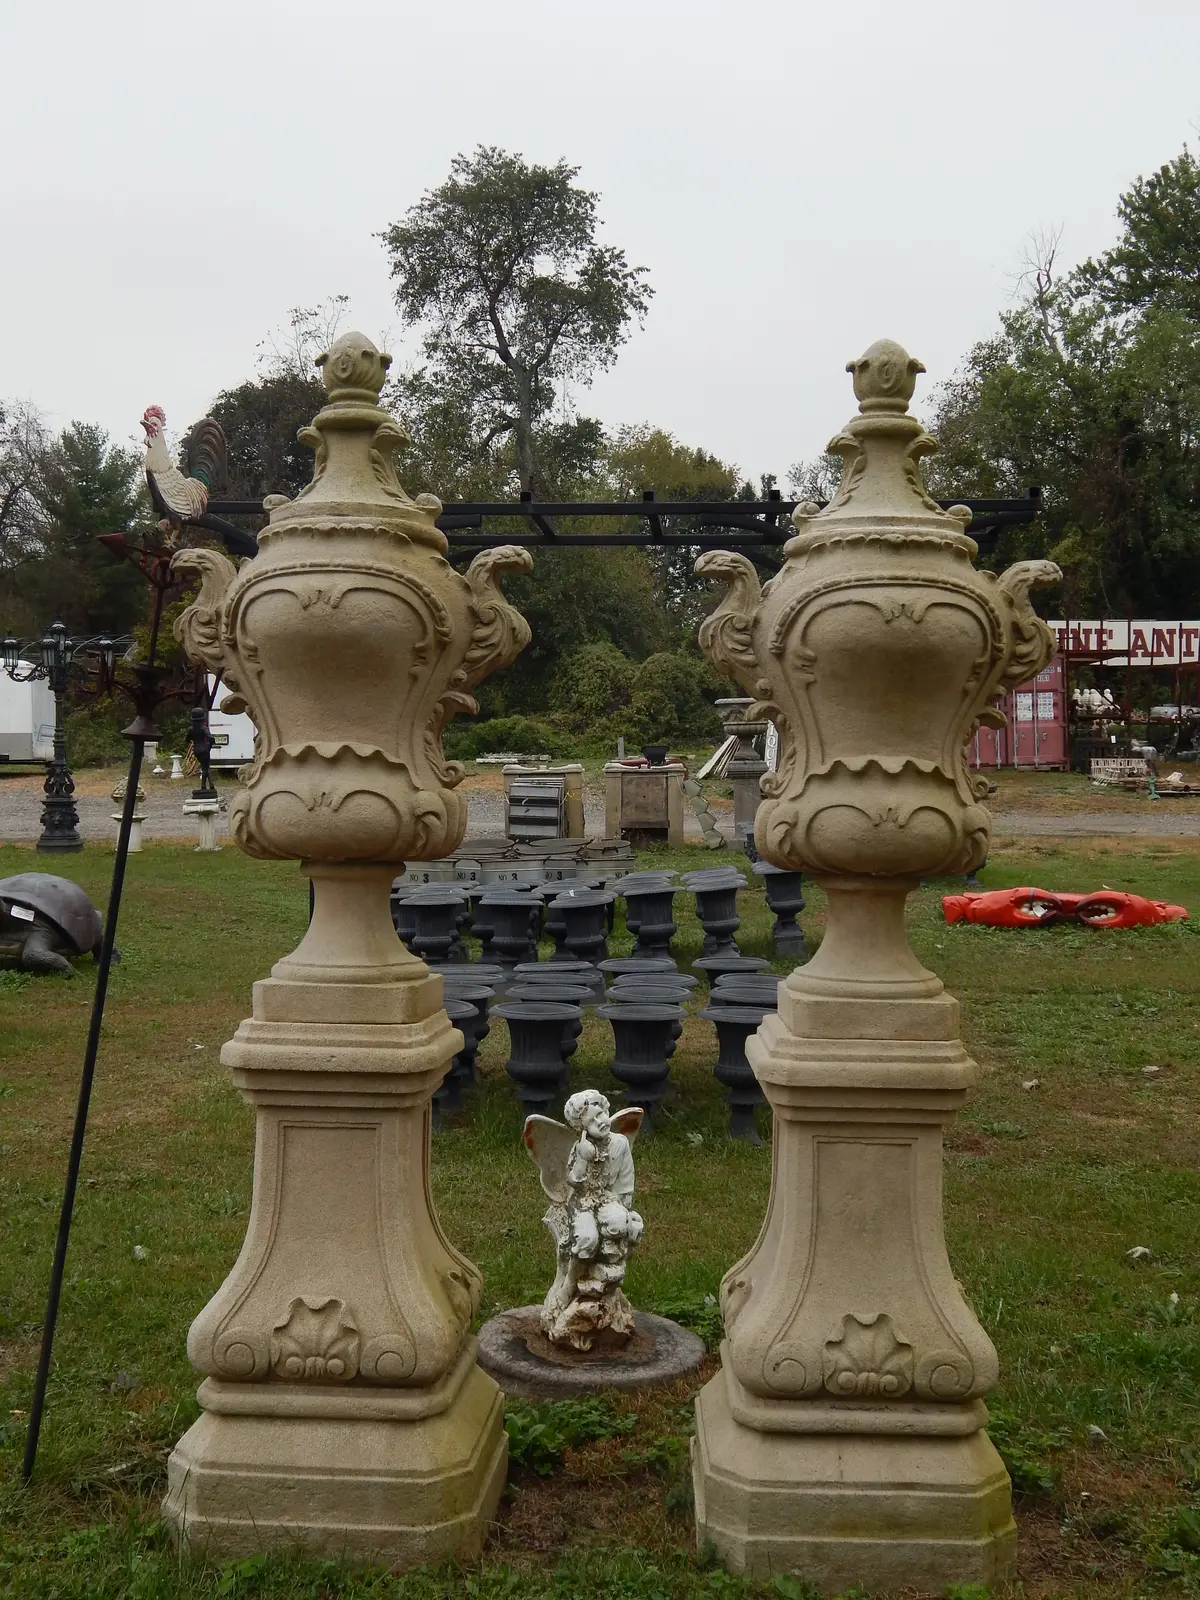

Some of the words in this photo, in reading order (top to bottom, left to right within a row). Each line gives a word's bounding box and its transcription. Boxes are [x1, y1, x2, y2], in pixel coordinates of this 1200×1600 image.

[409, 873, 419, 882] NO
[423, 873, 429, 883] 3
[470, 872, 476, 881] 3
[556, 871, 563, 881] 3
